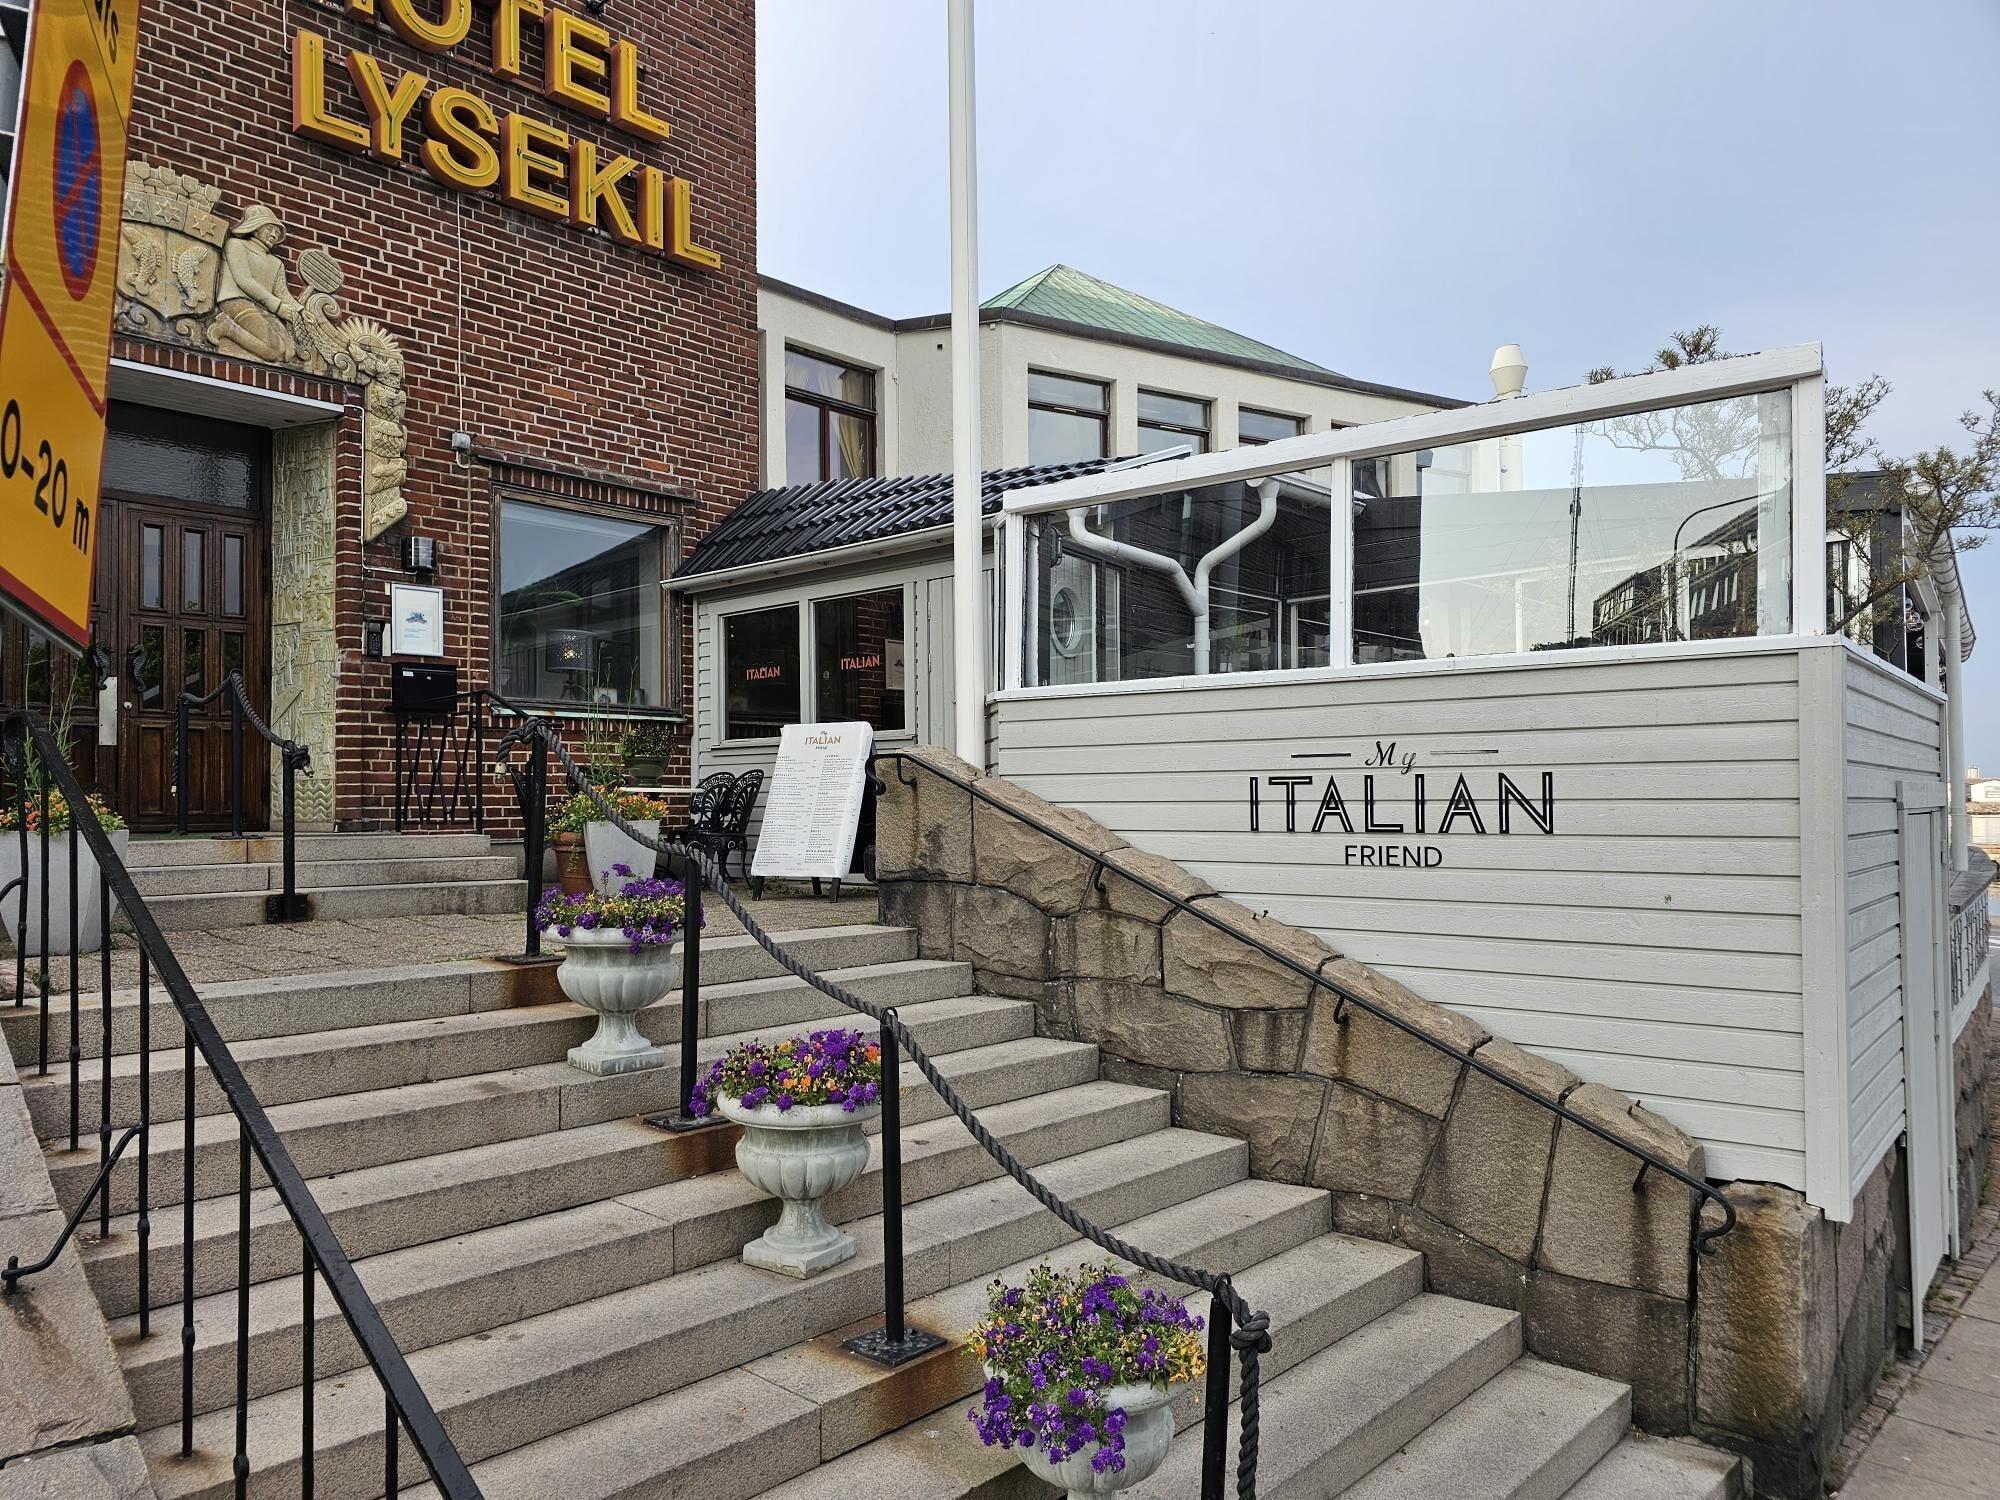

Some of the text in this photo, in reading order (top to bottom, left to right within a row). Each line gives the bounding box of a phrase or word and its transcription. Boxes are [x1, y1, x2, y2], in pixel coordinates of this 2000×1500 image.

[293, 29, 721, 270] LYSEKIL
[0, 399, 89, 555] 0-20 m
[841, 655, 880, 670] ITALIAN
[805, 736, 842, 745] ITALIAN
[1365, 741, 1417, 775] My
[1250, 772, 1554, 835] ITALIAN
[1345, 845, 1443, 867] FRIEND
